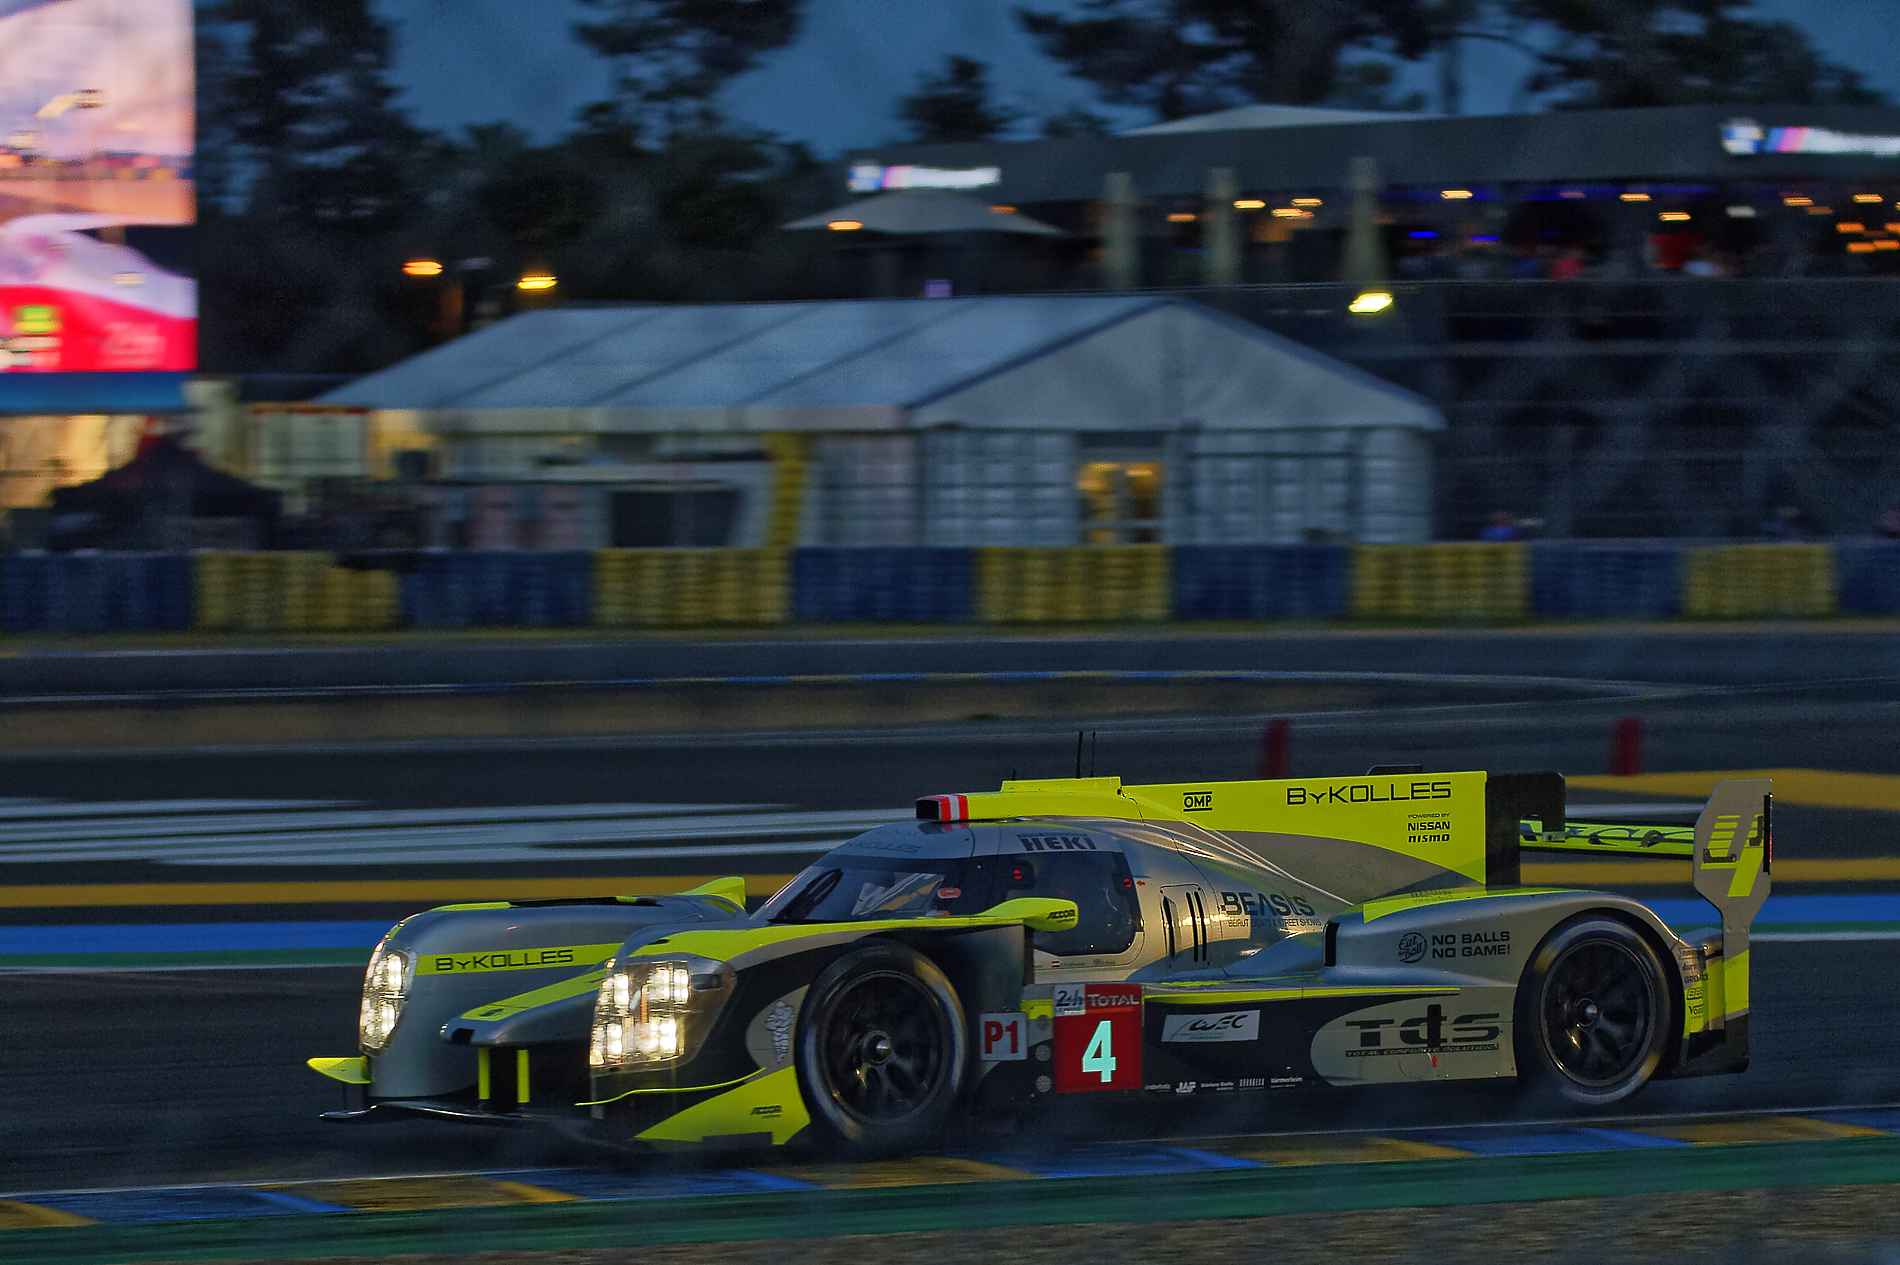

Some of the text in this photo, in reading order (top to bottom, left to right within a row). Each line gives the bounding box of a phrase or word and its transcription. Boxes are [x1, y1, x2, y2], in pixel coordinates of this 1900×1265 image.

[1184, 795, 1212, 808] OMP
[1407, 821, 1450, 831] NISSAN
[1431, 931, 1510, 946] NO BALLS
[1431, 947, 1456, 959] NO
[1461, 944, 1511, 957] GAME!
[1055, 990, 1083, 1007] 24h
[1088, 993, 1140, 1007] TOTAL
[984, 1020, 1018, 1054] P1
[1082, 1020, 1117, 1083] 4
